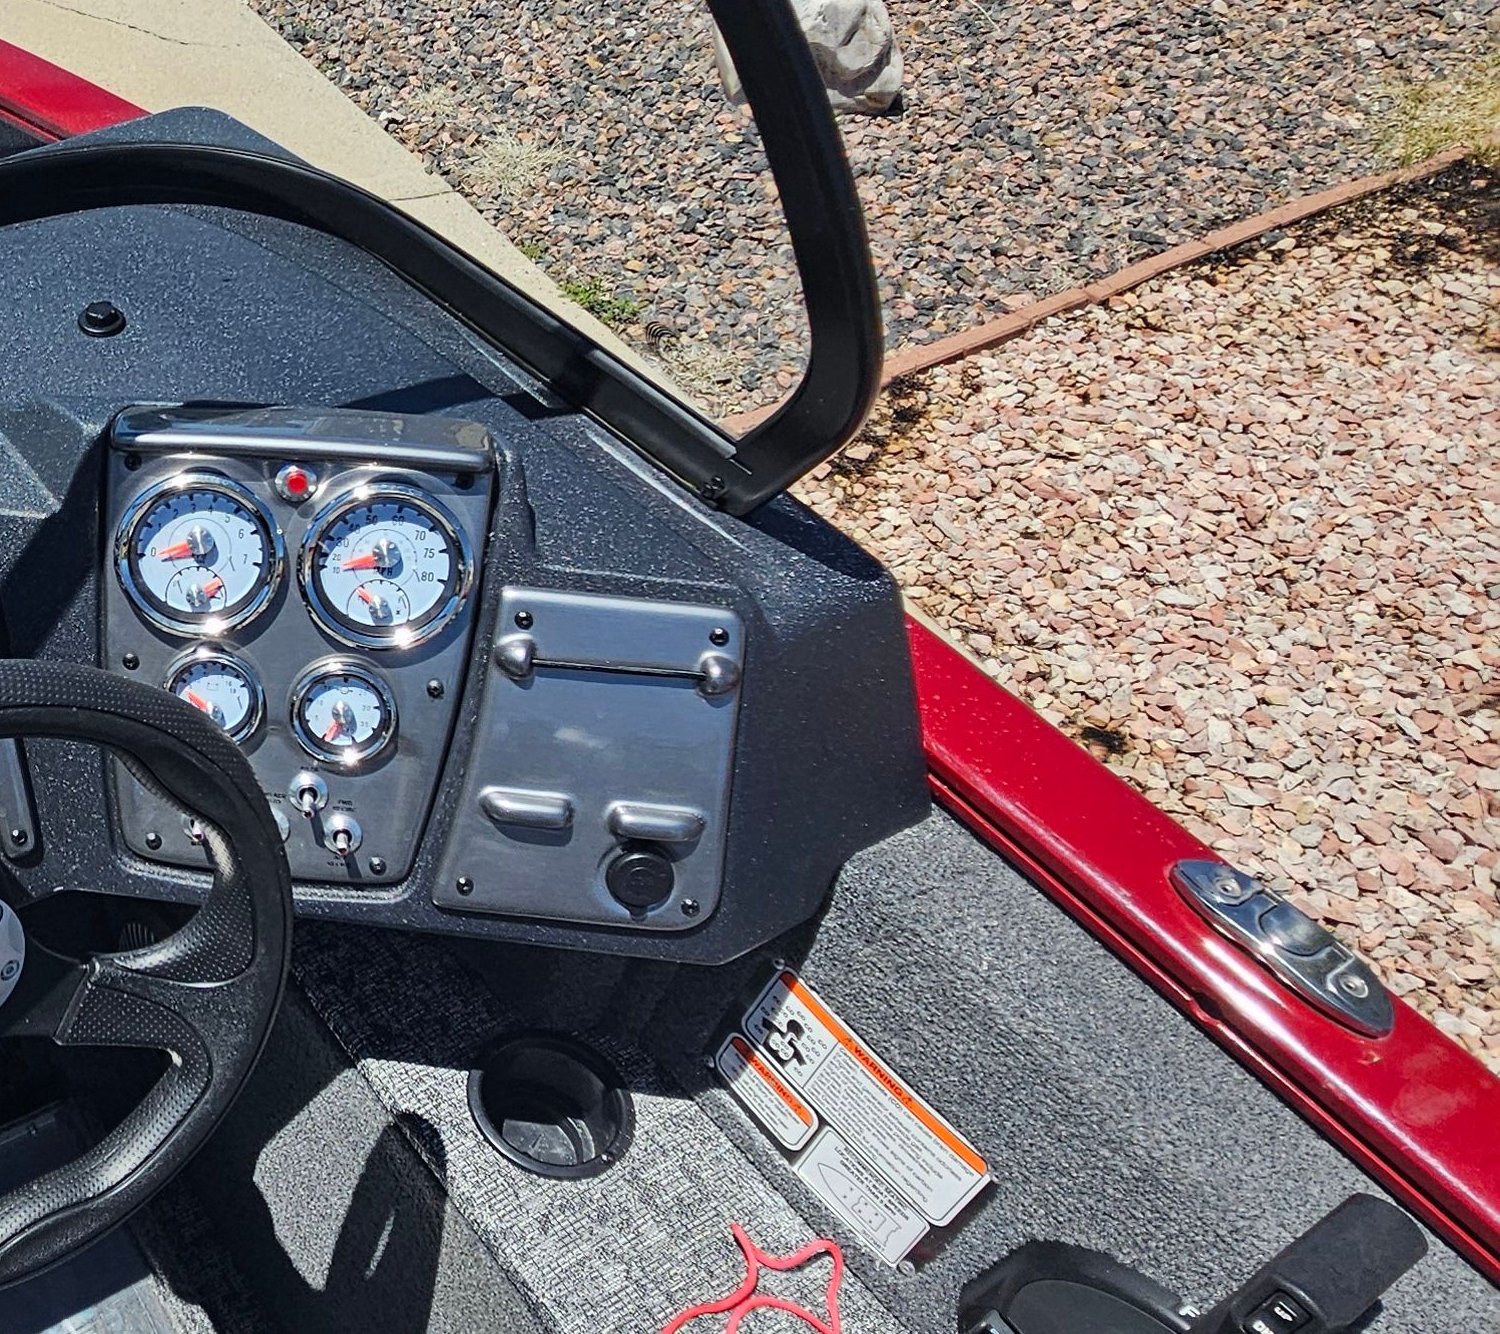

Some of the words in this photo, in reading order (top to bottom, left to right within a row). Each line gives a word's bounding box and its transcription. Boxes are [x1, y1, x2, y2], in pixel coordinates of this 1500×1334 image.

[365, 515, 378, 525] 50
[392, 515, 404, 527] 60
[415, 530, 426, 541] 70
[424, 549, 435, 559] 75
[421, 572, 434, 582] 80
[853, 1045, 903, 1097] WARNING
[834, 1145, 864, 1177] LOCATIONS
[864, 1175, 872, 1184] AT
[872, 1183, 887, 1200] BOAT
[887, 1197, 909, 1220] SPEEDS
